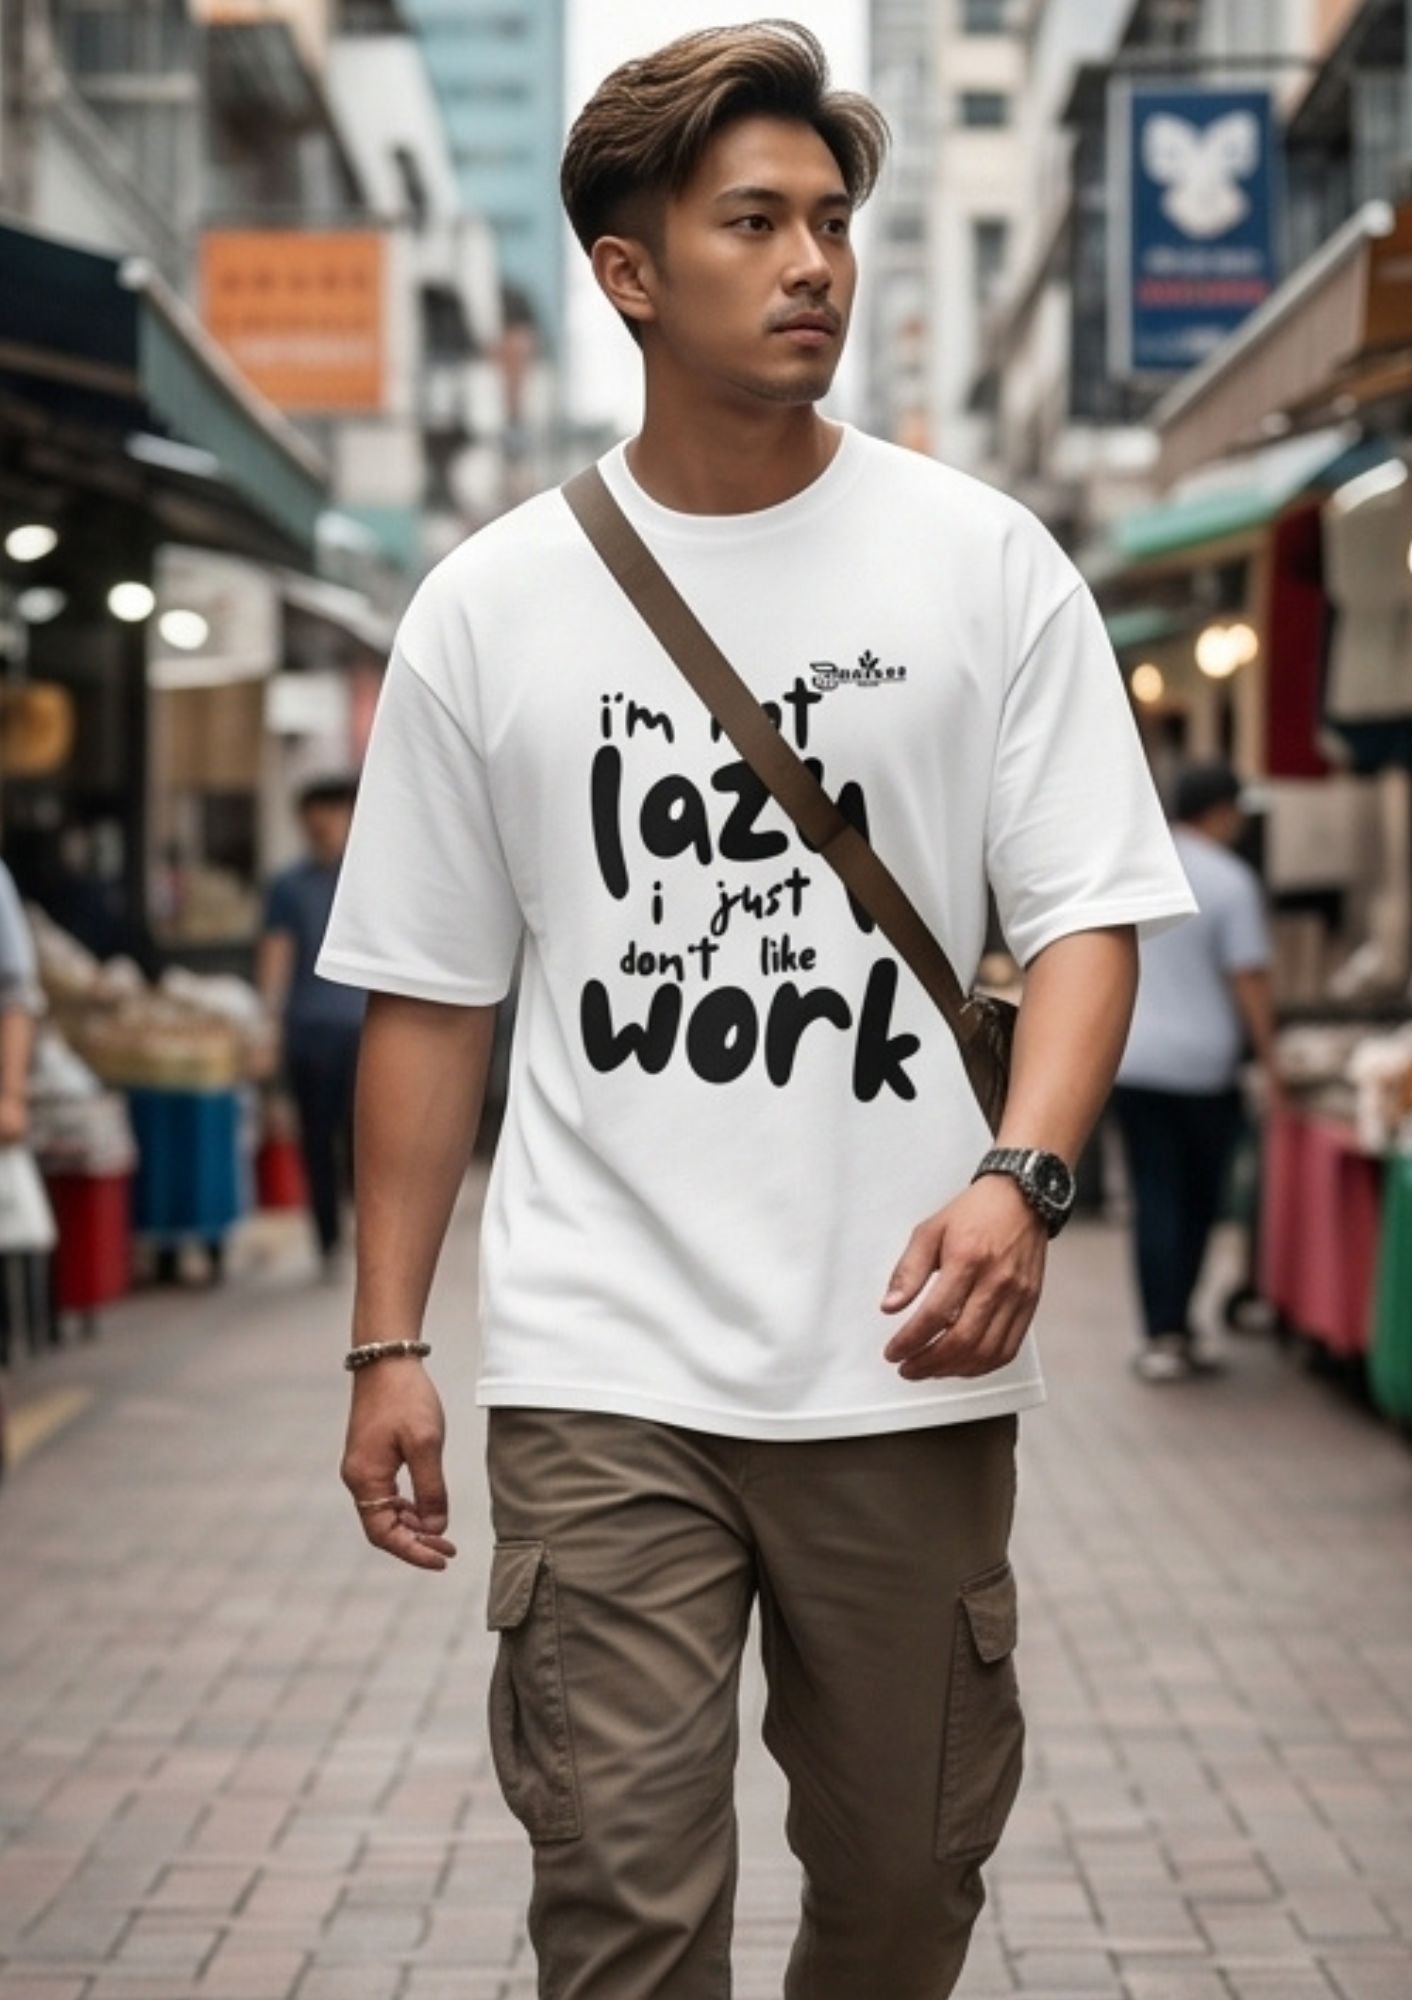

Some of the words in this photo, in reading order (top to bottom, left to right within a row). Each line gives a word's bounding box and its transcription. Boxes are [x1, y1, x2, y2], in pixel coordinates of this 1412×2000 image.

[601, 694, 674, 743] i'm
[652, 881, 663, 925] i
[710, 867, 811, 937] just
[620, 936, 720, 982] don't
[761, 933, 817, 977] like
[580, 957, 921, 1103] work
